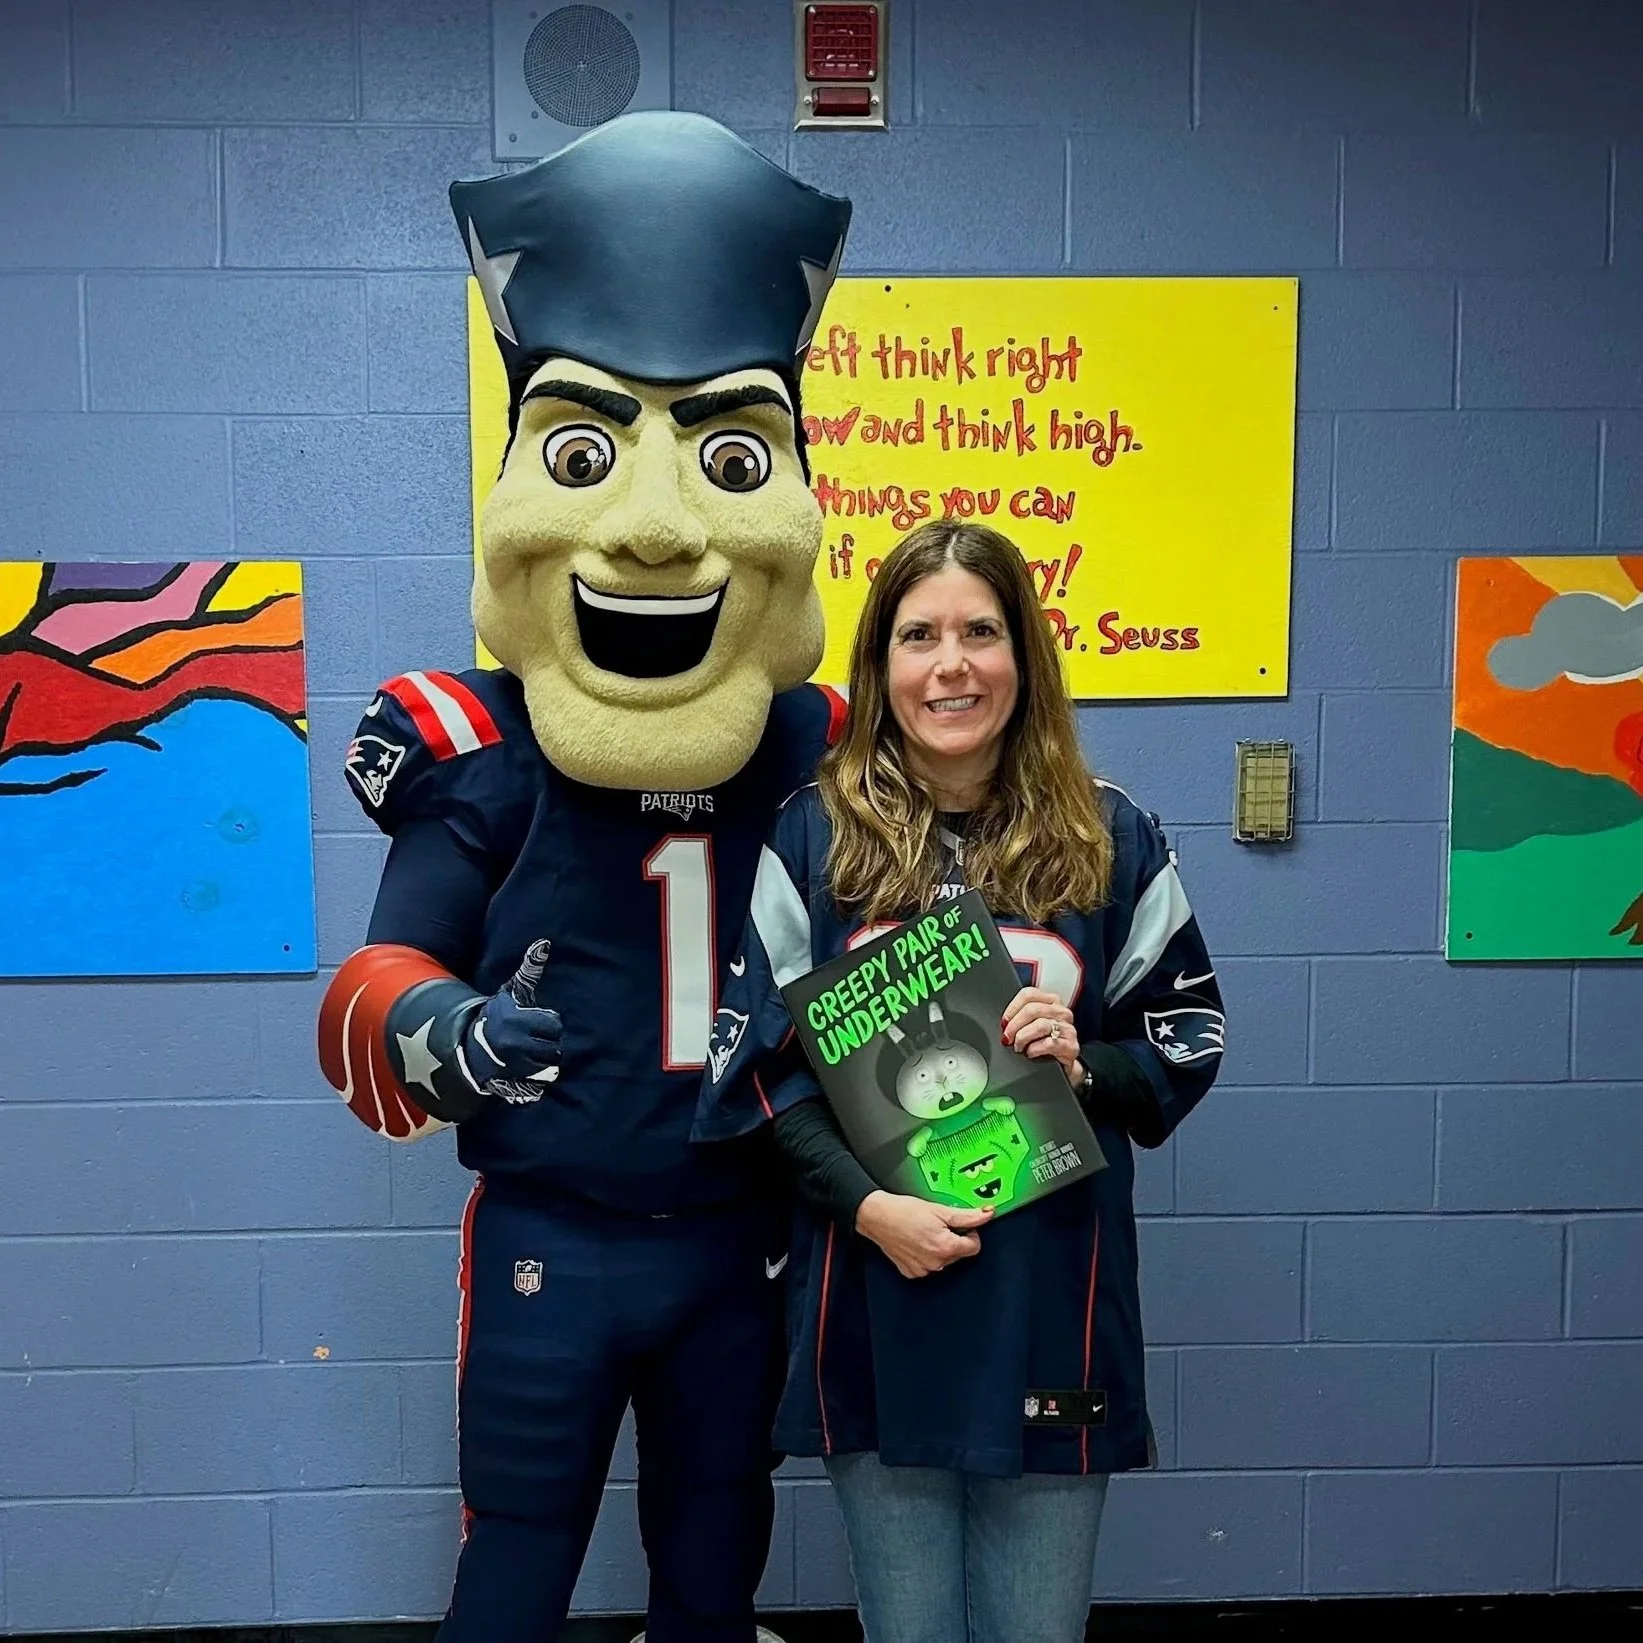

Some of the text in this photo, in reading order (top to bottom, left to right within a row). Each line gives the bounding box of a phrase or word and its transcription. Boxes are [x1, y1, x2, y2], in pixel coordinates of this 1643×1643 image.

[807, 325, 1082, 393] eft think right
[860, 398, 925, 447] and
[932, 398, 1037, 456] think
[1050, 409, 1143, 467] high.
[812, 473, 1076, 531] things you can
[829, 533, 855, 579] if
[1097, 611, 1201, 655] Seuss
[640, 793, 715, 813] PATRIOTS
[643, 835, 716, 1070] 1
[807, 949, 891, 1031] CREEPY
[892, 915, 947, 971] PAIR
[943, 905, 962, 929] OF
[816, 923, 990, 1065] UNDERWEAR!
